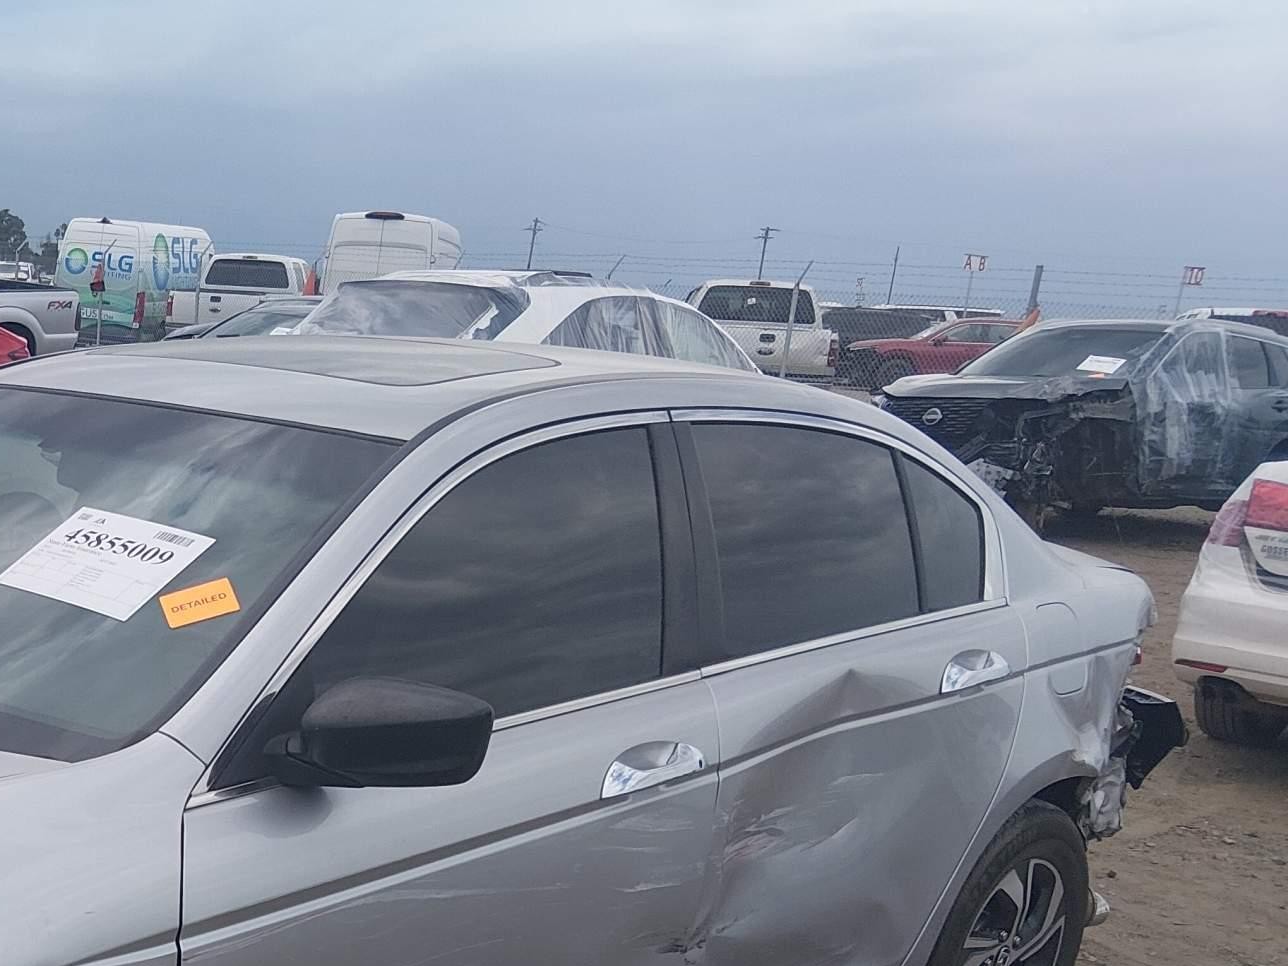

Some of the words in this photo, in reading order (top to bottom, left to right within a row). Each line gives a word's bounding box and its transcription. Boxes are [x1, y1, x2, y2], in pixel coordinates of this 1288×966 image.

[91, 250, 134, 273] SLG
[170, 236, 199, 274] SLG
[64, 529, 174, 565] 45855009
[170, 592, 227, 614] DETAILED
